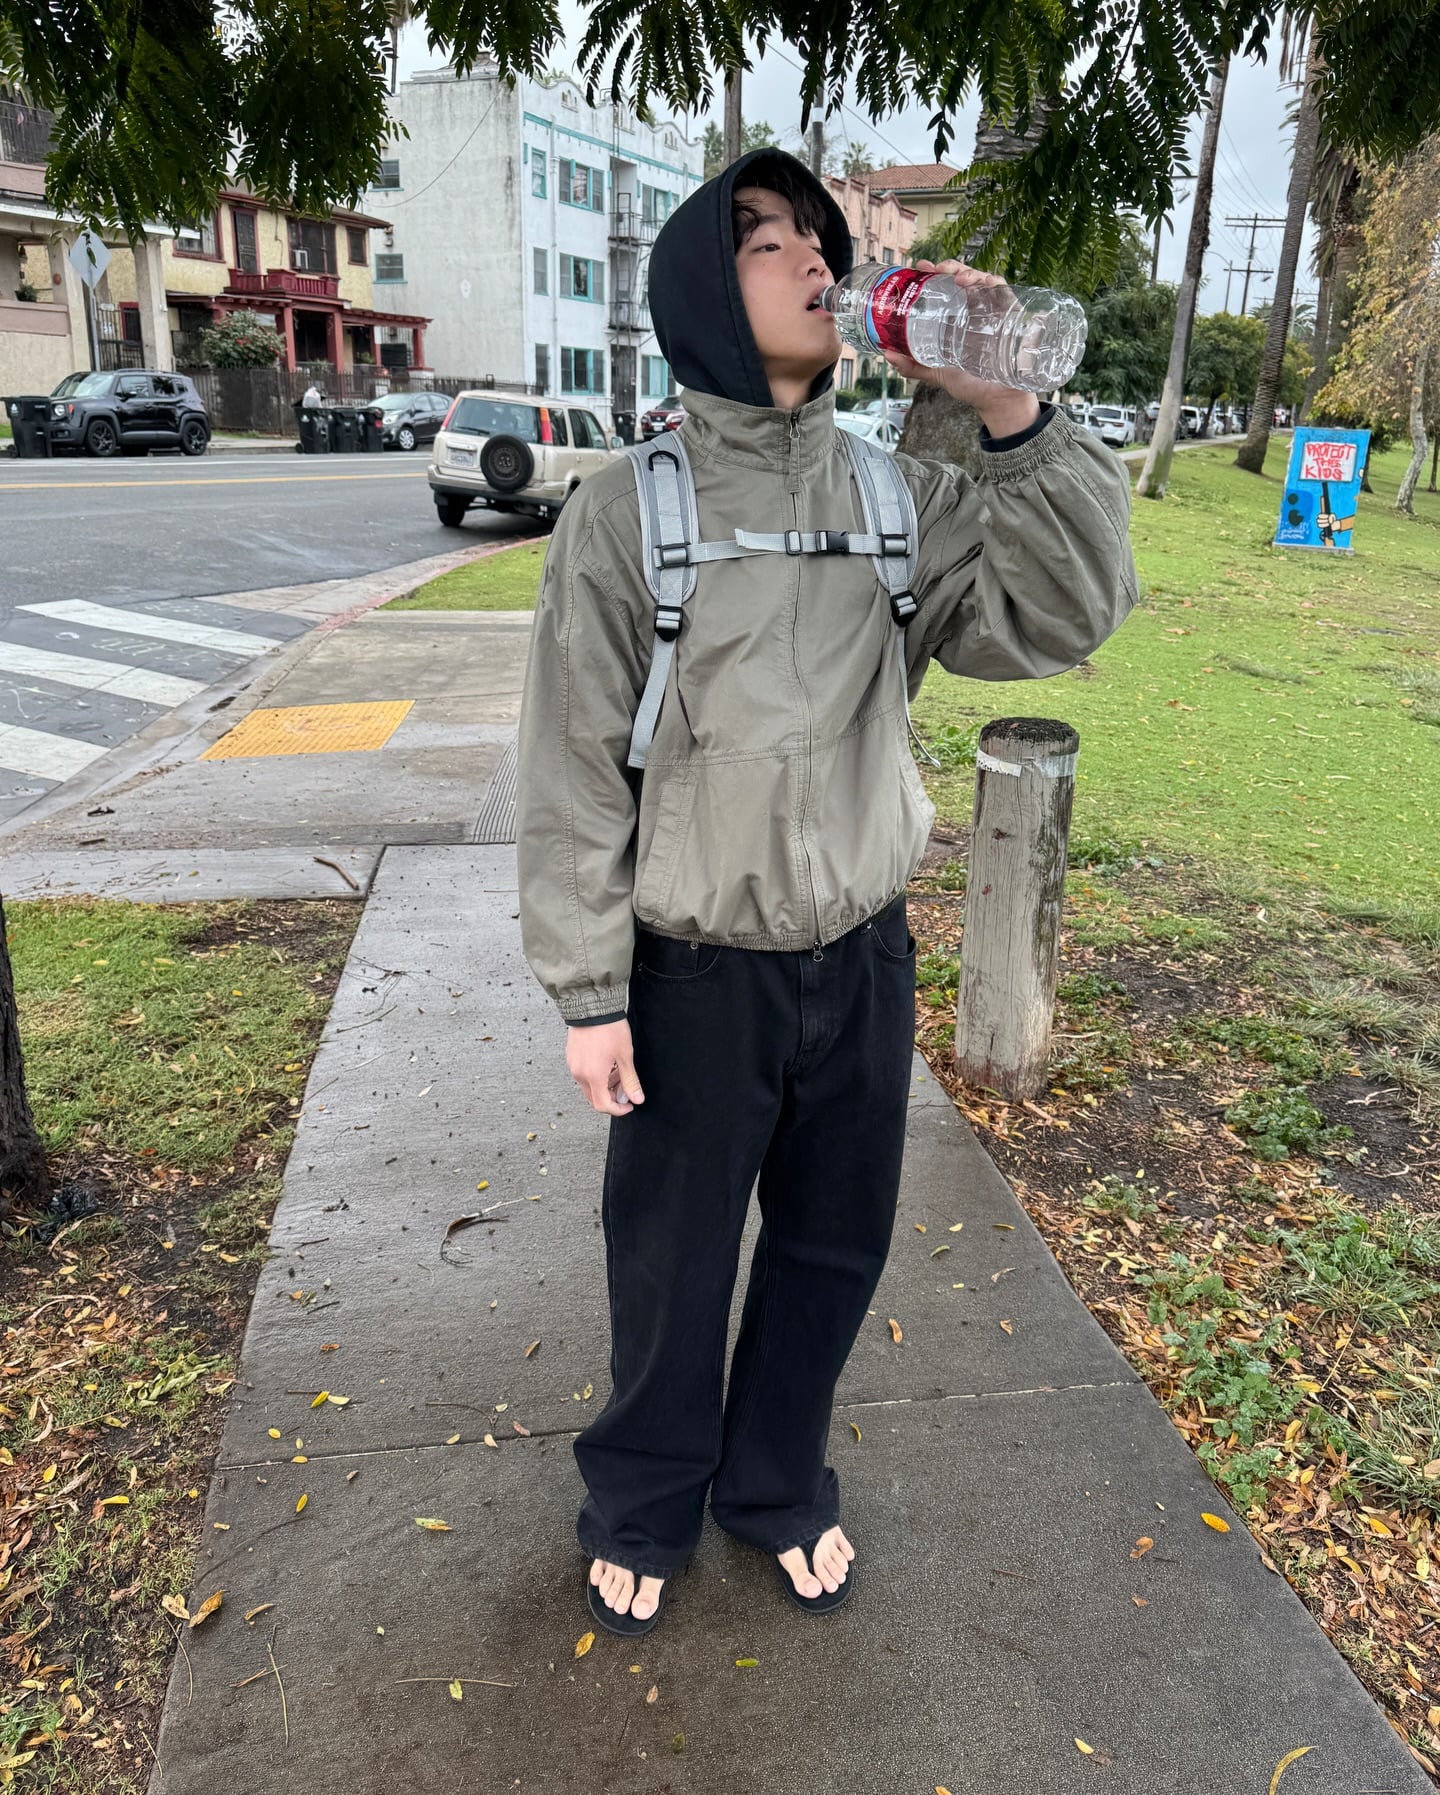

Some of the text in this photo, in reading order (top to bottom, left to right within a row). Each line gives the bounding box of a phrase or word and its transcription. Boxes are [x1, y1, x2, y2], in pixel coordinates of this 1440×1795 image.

[877, 276, 899, 315] ARROWHEAD
[1306, 443, 1355, 460] PROTECT
[1312, 458, 1342, 468] THE
[1305, 464, 1344, 480] KIDS
